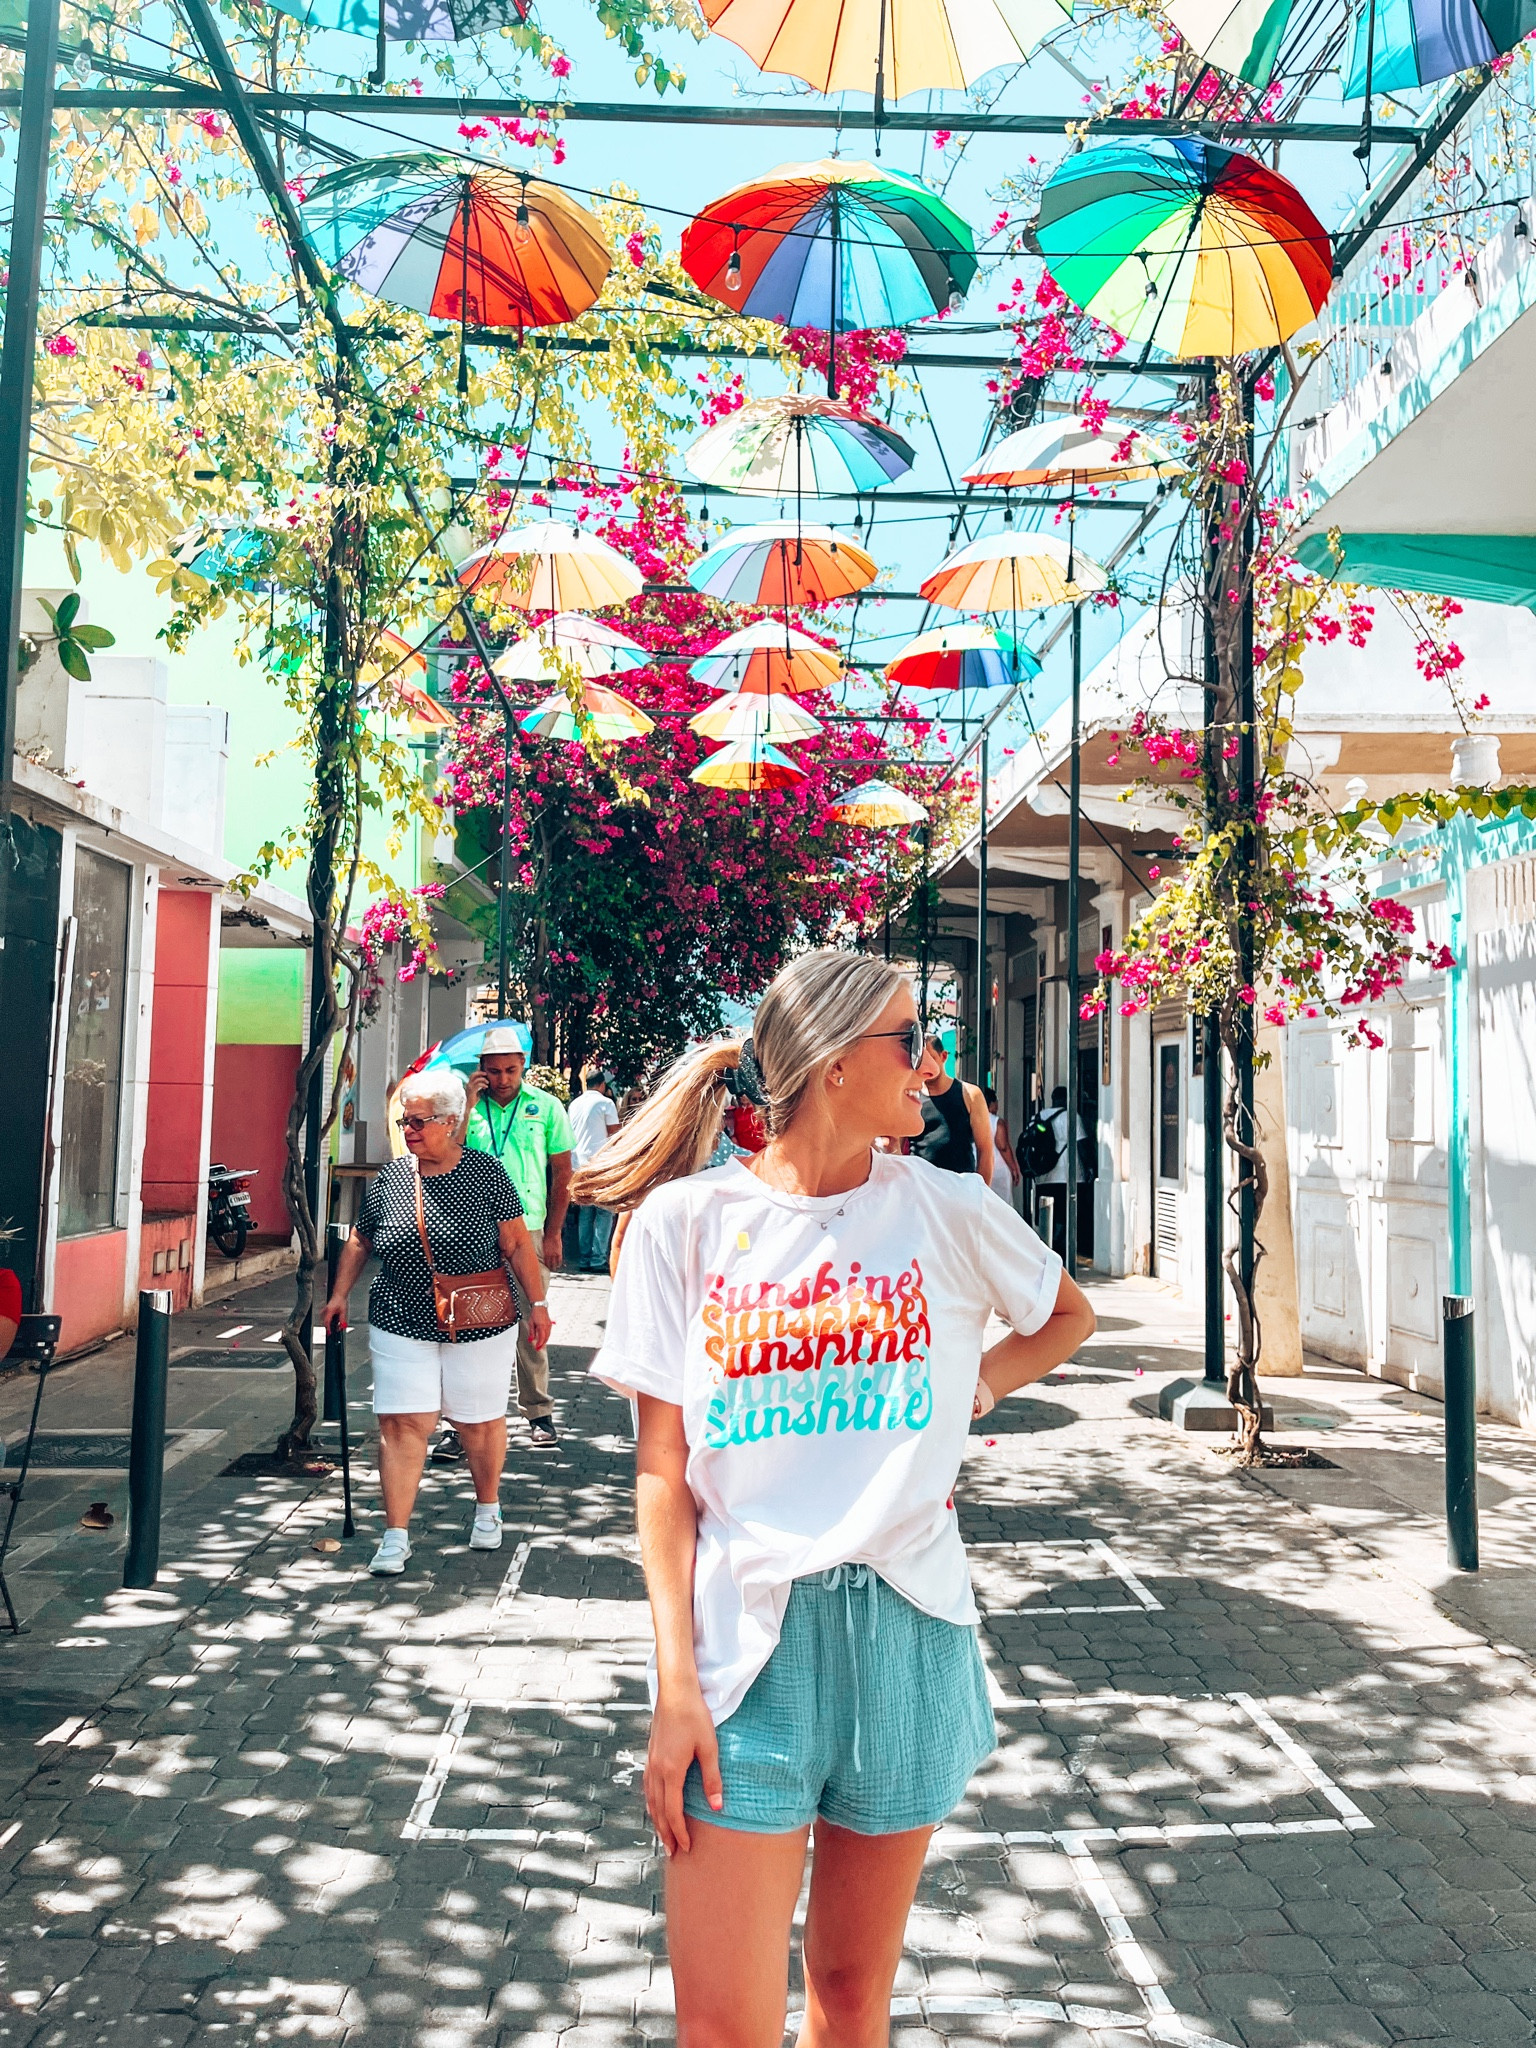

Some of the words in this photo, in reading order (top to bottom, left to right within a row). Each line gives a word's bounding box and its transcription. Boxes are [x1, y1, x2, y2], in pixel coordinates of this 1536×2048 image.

[702, 1287, 928, 1345] Sunshine
[704, 1313, 931, 1381] Sunshine
[705, 1377, 933, 1449] Sunshine
